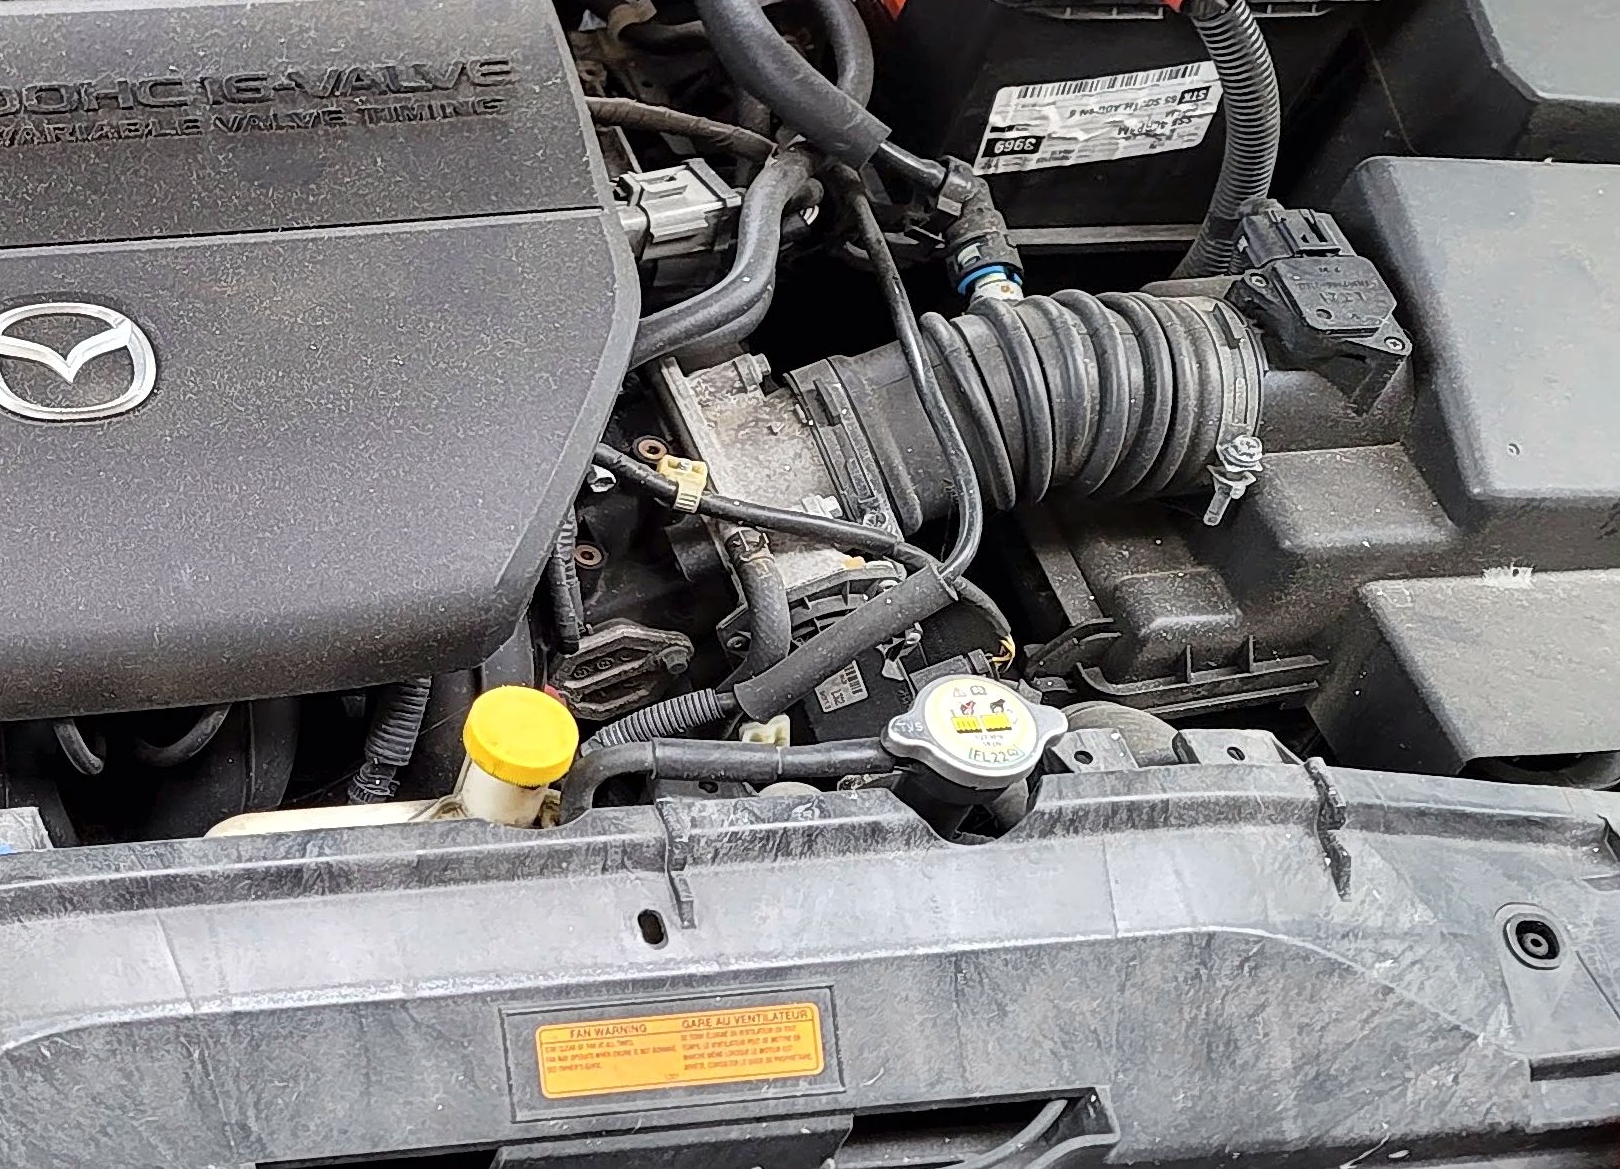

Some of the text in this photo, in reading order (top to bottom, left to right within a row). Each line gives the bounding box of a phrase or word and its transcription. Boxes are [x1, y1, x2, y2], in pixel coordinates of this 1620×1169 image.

[198, 56, 514, 105] 16-VALVE
[212, 107, 347, 133] VALVE
[356, 97, 509, 125] TIMING
[993, 137, 1037, 154] 3969
[974, 750, 1010, 763] FL22
[716, 1015, 731, 1026] AU
[570, 1027, 592, 1039] FAN
